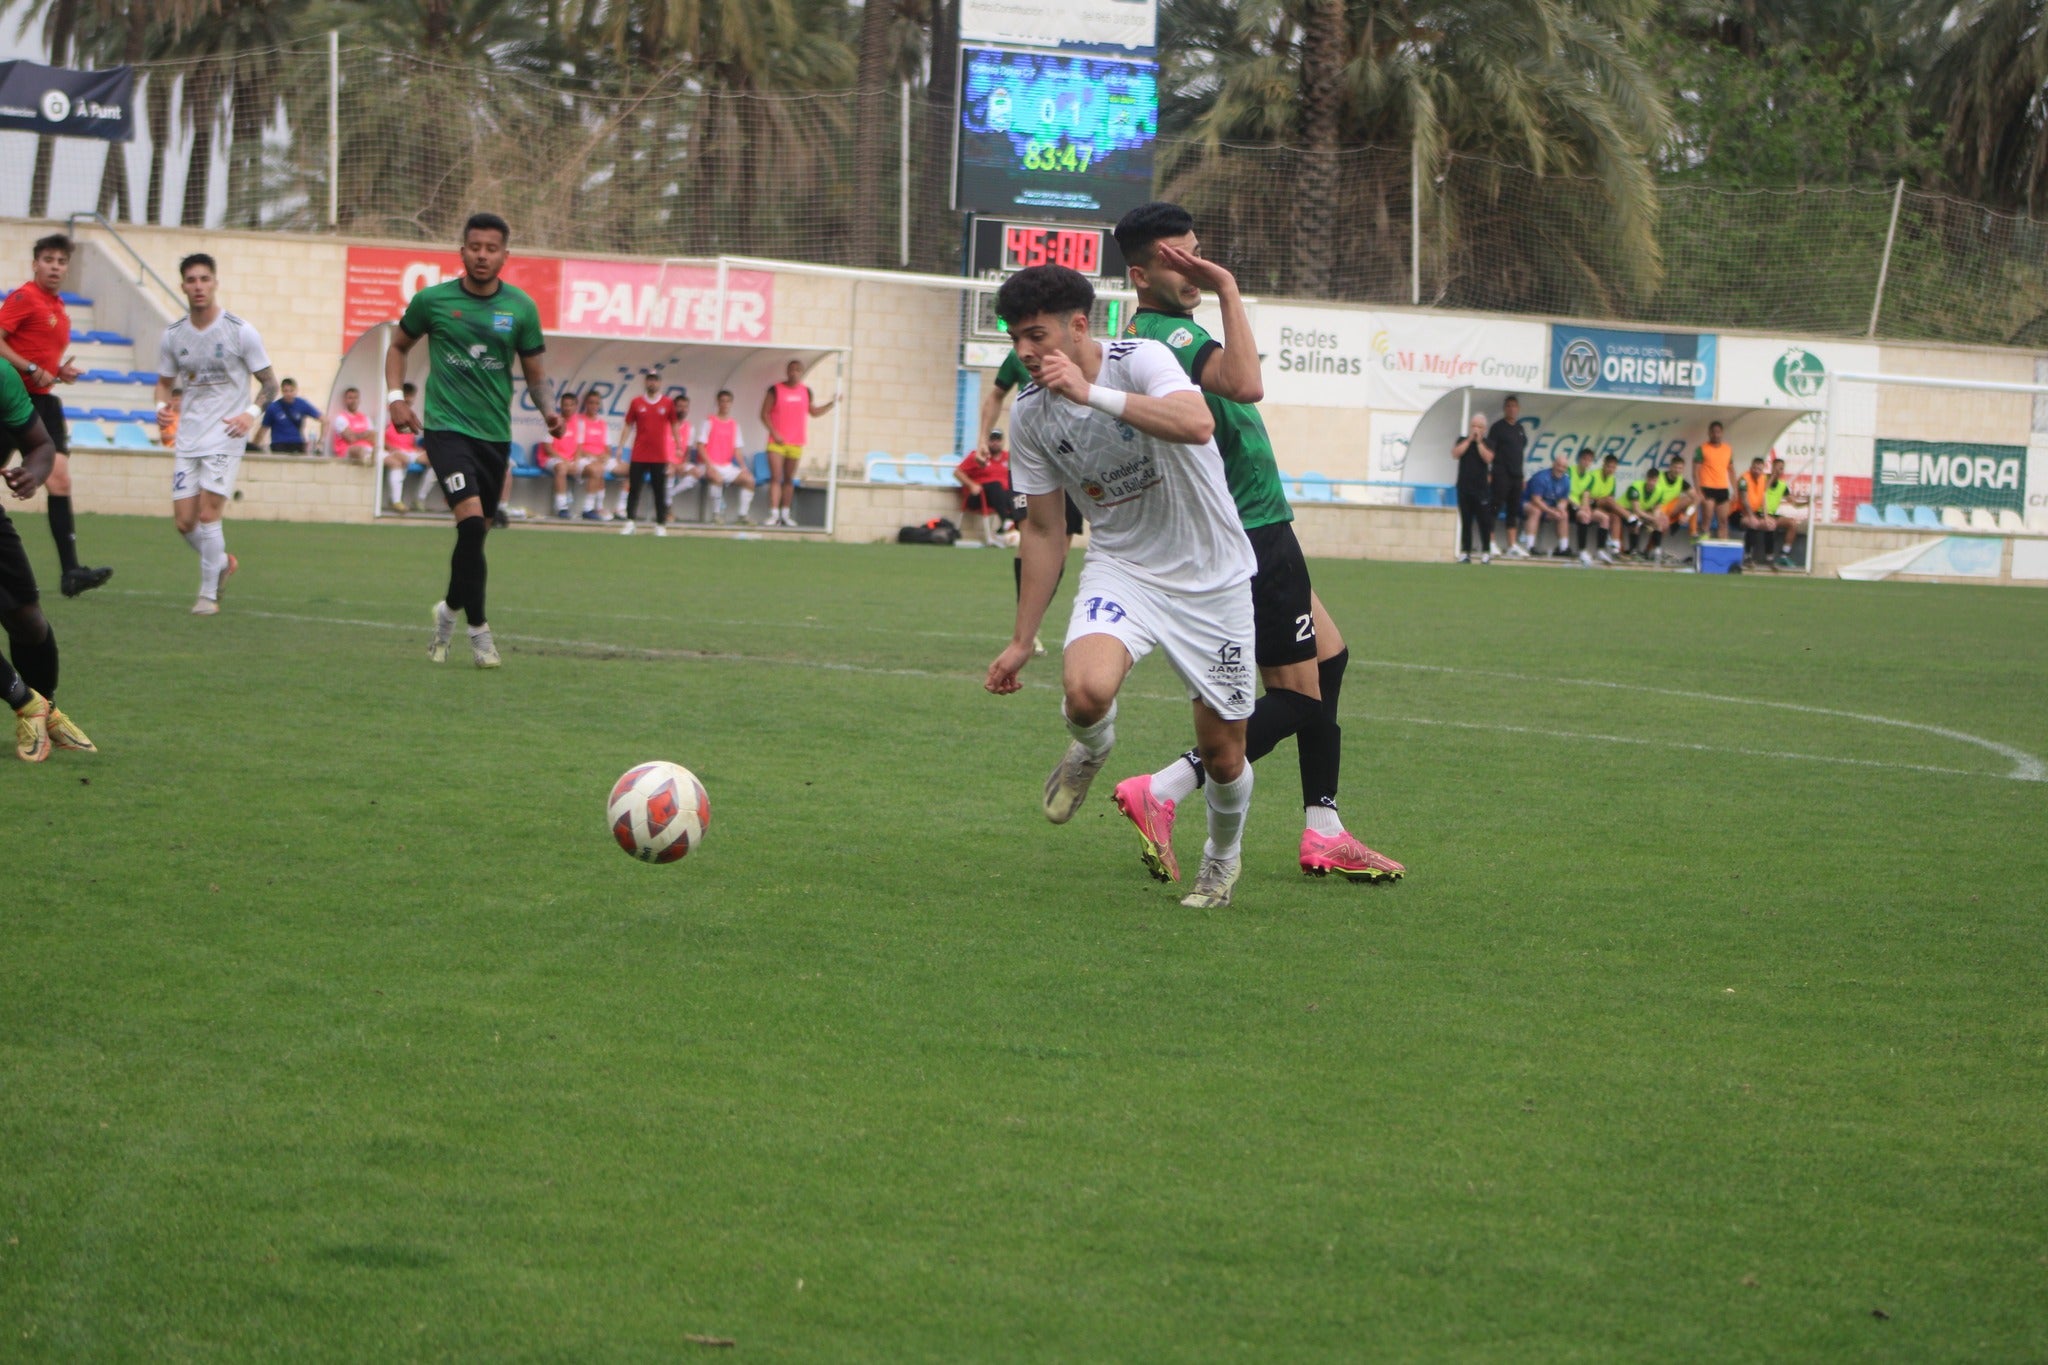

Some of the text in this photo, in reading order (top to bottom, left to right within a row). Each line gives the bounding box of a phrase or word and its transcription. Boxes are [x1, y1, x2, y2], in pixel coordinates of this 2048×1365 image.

[1041, 98, 1080, 126] 0 1
[1024, 137, 1094, 173] 83:47
[1007, 226, 1099, 273] 45:00
[568, 280, 766, 338] PANTER
[1280, 327, 1338, 349] Redes
[1279, 348, 1361, 375] Salinas
[1382, 351, 1539, 384] GM Mufer Group
[1603, 355, 1706, 387] ORISMED
[445, 472, 466, 494] 10
[1920, 454, 2019, 489] MORA
[1013, 494, 1027, 509] 18
[1208, 665, 1246, 673] JAMA
